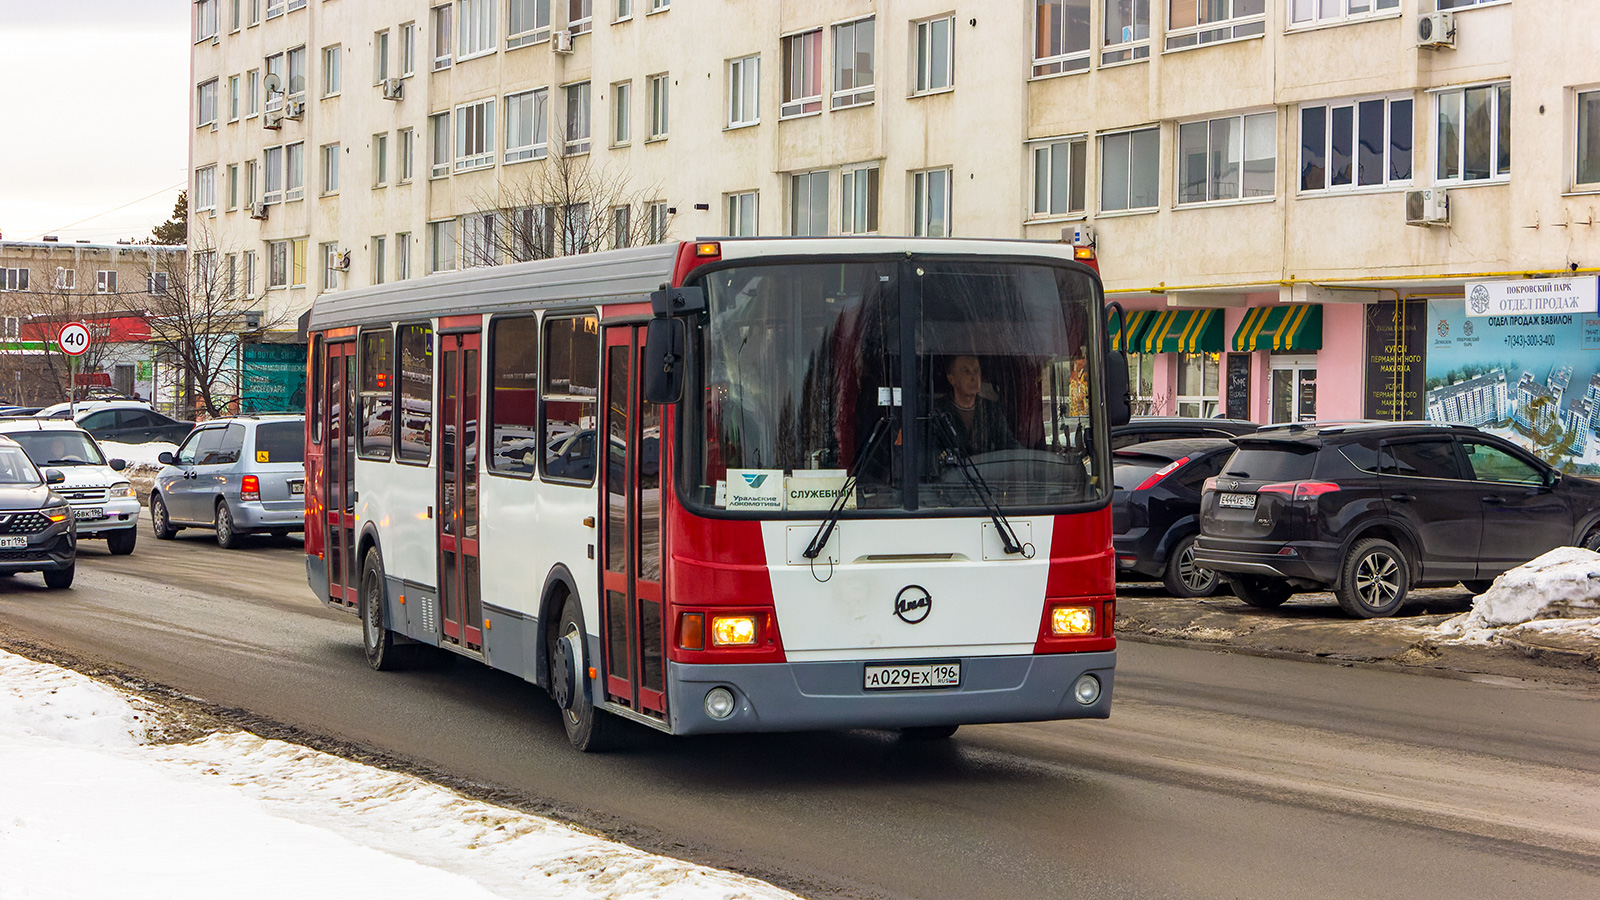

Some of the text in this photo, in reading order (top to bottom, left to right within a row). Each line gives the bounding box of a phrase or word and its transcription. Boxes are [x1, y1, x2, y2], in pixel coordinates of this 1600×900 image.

[1506, 282, 1572, 295] ПОКРОВСКИЙ ПАРК
[1499, 296, 1580, 311] ОТДЕЛ ПРОДАЖ
[1488, 315, 1573, 327] ОТДЕЛ ПРОДАЖ ВАВИЛОН
[64, 332, 85, 346] 40
[1504, 334, 1555, 348] +7(343)-300-3-400
[1370, 355, 1422, 363] ПЕРМАННТНОГО
[933, 666, 956, 679] 196
